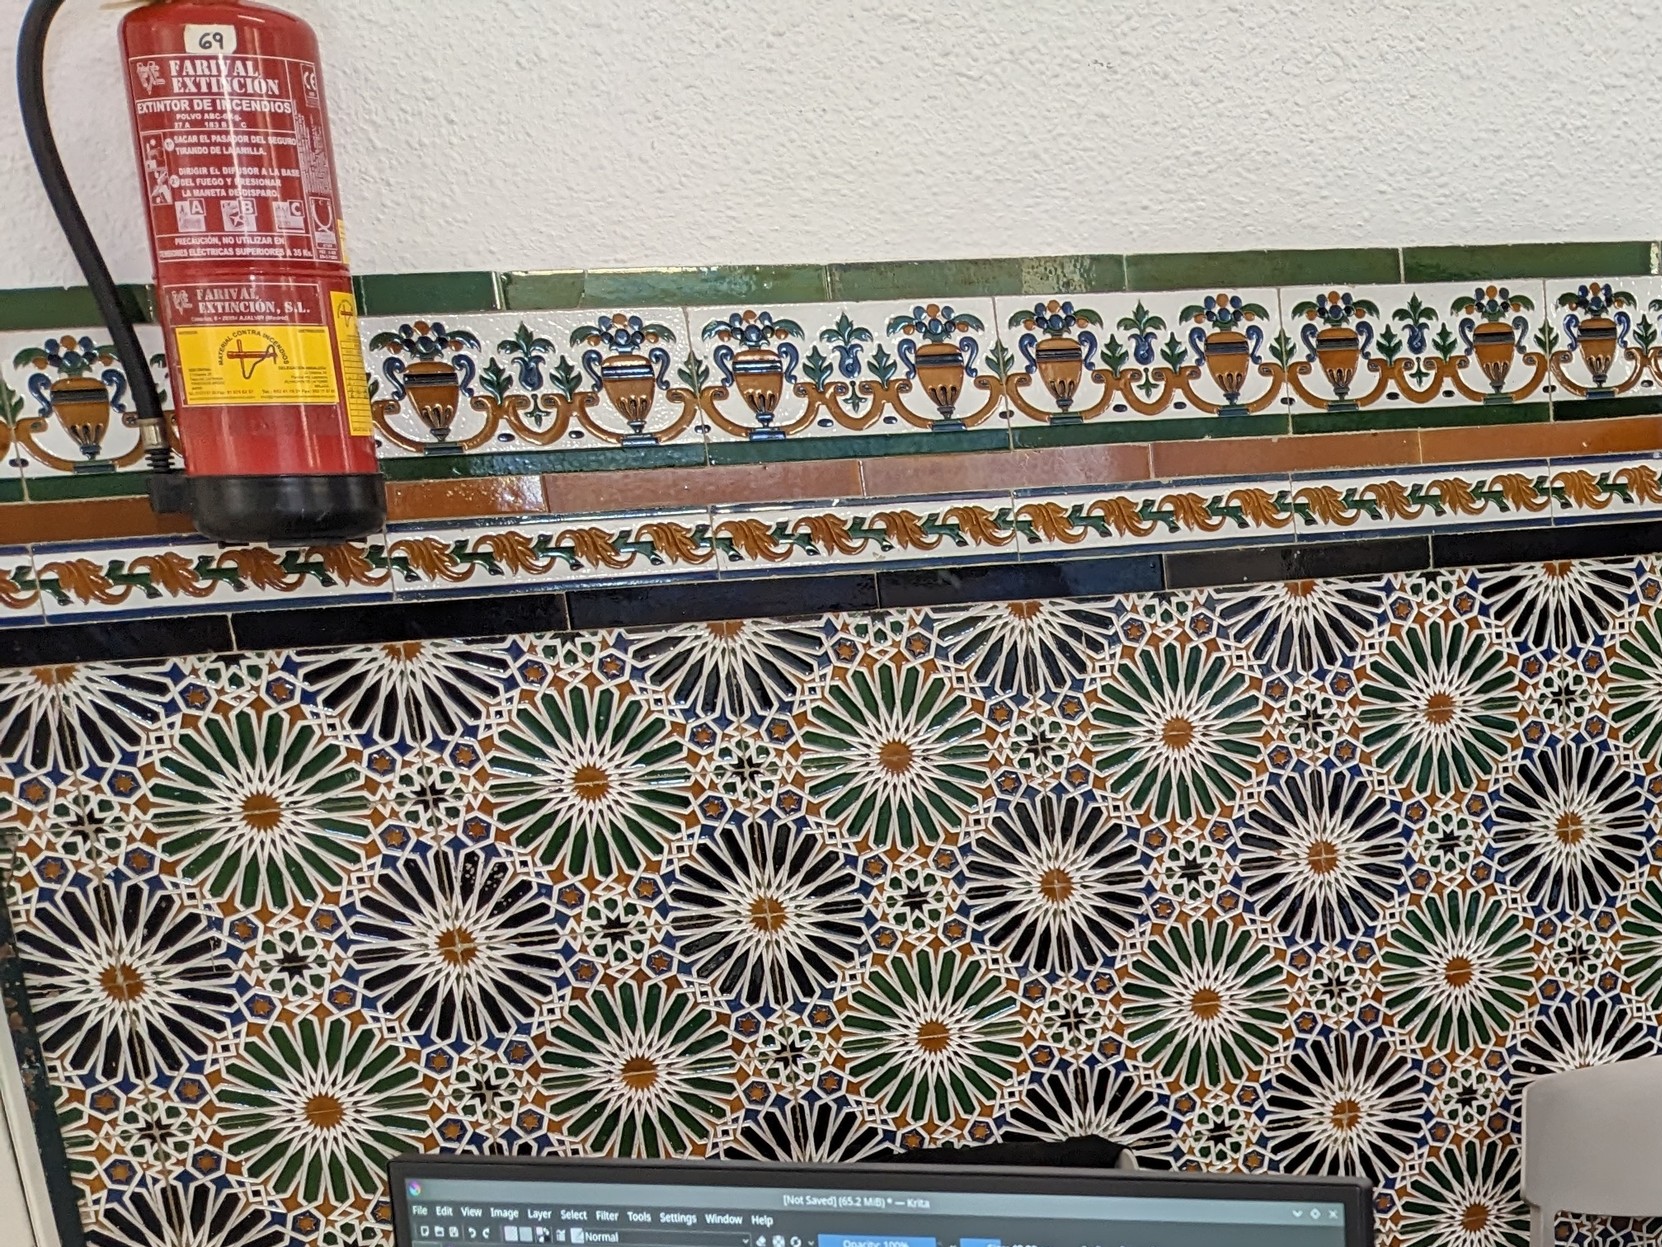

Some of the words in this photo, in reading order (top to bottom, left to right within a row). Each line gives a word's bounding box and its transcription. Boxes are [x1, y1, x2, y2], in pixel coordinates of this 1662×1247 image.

[199, 32, 224, 50] 69
[169, 59, 258, 77] FARIVAL
[172, 73, 280, 95] EXTINCIÓN
[137, 99, 190, 114] EXTINTOR
[194, 99, 212, 111] DE
[217, 99, 292, 114] INCENDIOS
[176, 113, 201, 121] POLVO
[174, 135, 198, 144] SACAR
[200, 135, 210, 143] EL
[211, 135, 249, 143] PASADOR
[251, 136, 266, 144] DEL
[268, 137, 296, 145] SEGURO
[175, 147, 208, 155] TIRANDO
[179, 167, 208, 175] DIRIGIR
[222, 167, 259, 175] DIFUSOR
[270, 168, 280, 176] LA
[281, 169, 300, 177] BASE
[181, 179, 194, 187] DEL
[196, 178, 224, 186] FUEGO
[181, 189, 191, 197] LA
[191, 201, 204, 214] A
[242, 201, 254, 214] B
[290, 202, 301, 215] C
[175, 237, 221, 246] PRECAUCIÓN,
[223, 237, 233, 245] NO
[236, 237, 272, 245] UTILIZAR
[274, 237, 285, 245] EN
[235, 248, 285, 257] SUPERIORES
[196, 287, 259, 301] FARIVAL
[199, 299, 280, 314] EXTINCIÓN,
[284, 302, 310, 314] S.L.
[217, 336, 233, 366] MATERIAL
[232, 329, 261, 338] CONTRA
[262, 333, 289, 365] INCENDIOS
[784, 1195, 804, 1206] [Not
[805, 1195, 837, 1207] Saved]
[838, 1196, 861, 1208] (65.2
[906, 1198, 931, 1210] Krita
[412, 1206, 428, 1217] File
[435, 1206, 453, 1217] Edit
[461, 1206, 483, 1218] View
[490, 1208, 519, 1220] Image
[528, 1209, 552, 1221] Layer
[561, 1210, 588, 1221] Select
[596, 1210, 619, 1222] Filter
[627, 1211, 651, 1222] Tools
[660, 1212, 697, 1225] Settings
[705, 1213, 743, 1225] Window
[751, 1215, 774, 1227] Help
[585, 1231, 618, 1243] Normal
